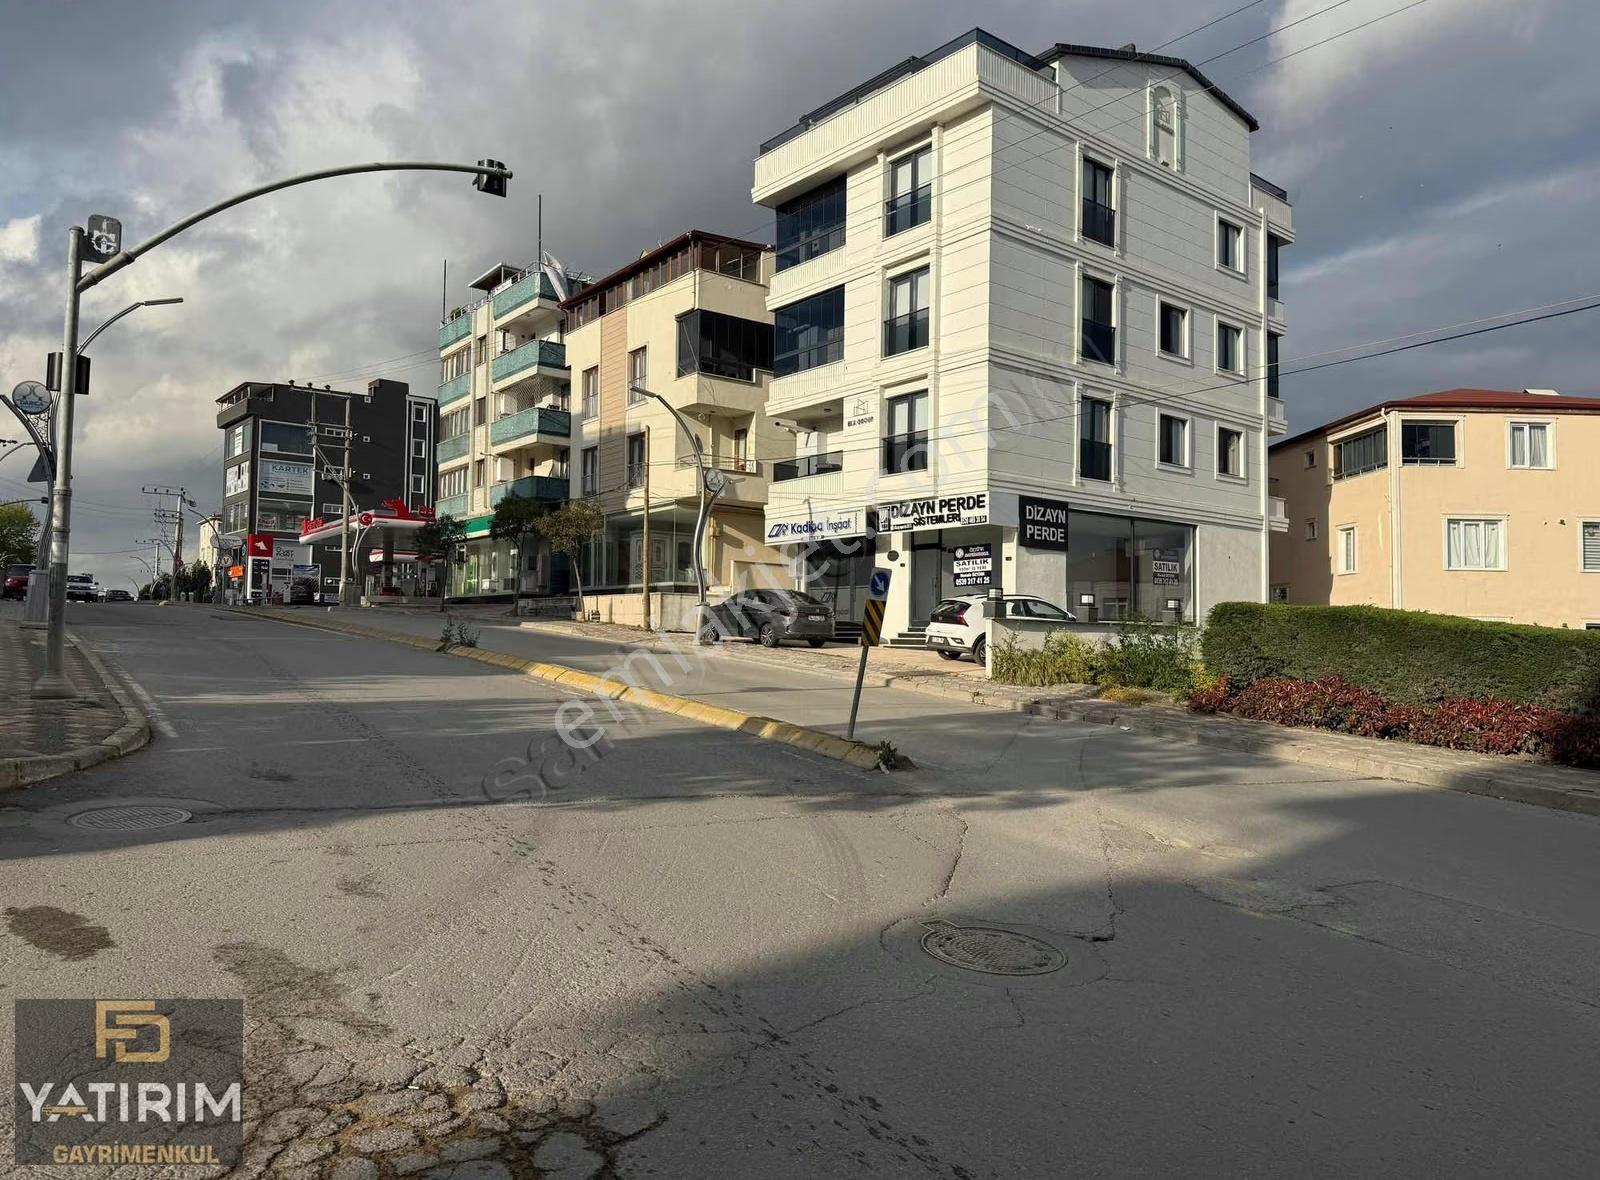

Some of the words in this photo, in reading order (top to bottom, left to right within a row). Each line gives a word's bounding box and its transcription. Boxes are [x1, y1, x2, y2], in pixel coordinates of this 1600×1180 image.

[891, 499, 936, 519] DİZAYN
[938, 493, 986, 514] PERDE
[1025, 504, 1066, 524] DİZAYN
[1026, 524, 1065, 543] PERDE
[955, 559, 989, 568] SATILIK
[1154, 562, 1178, 572] SATILIK
